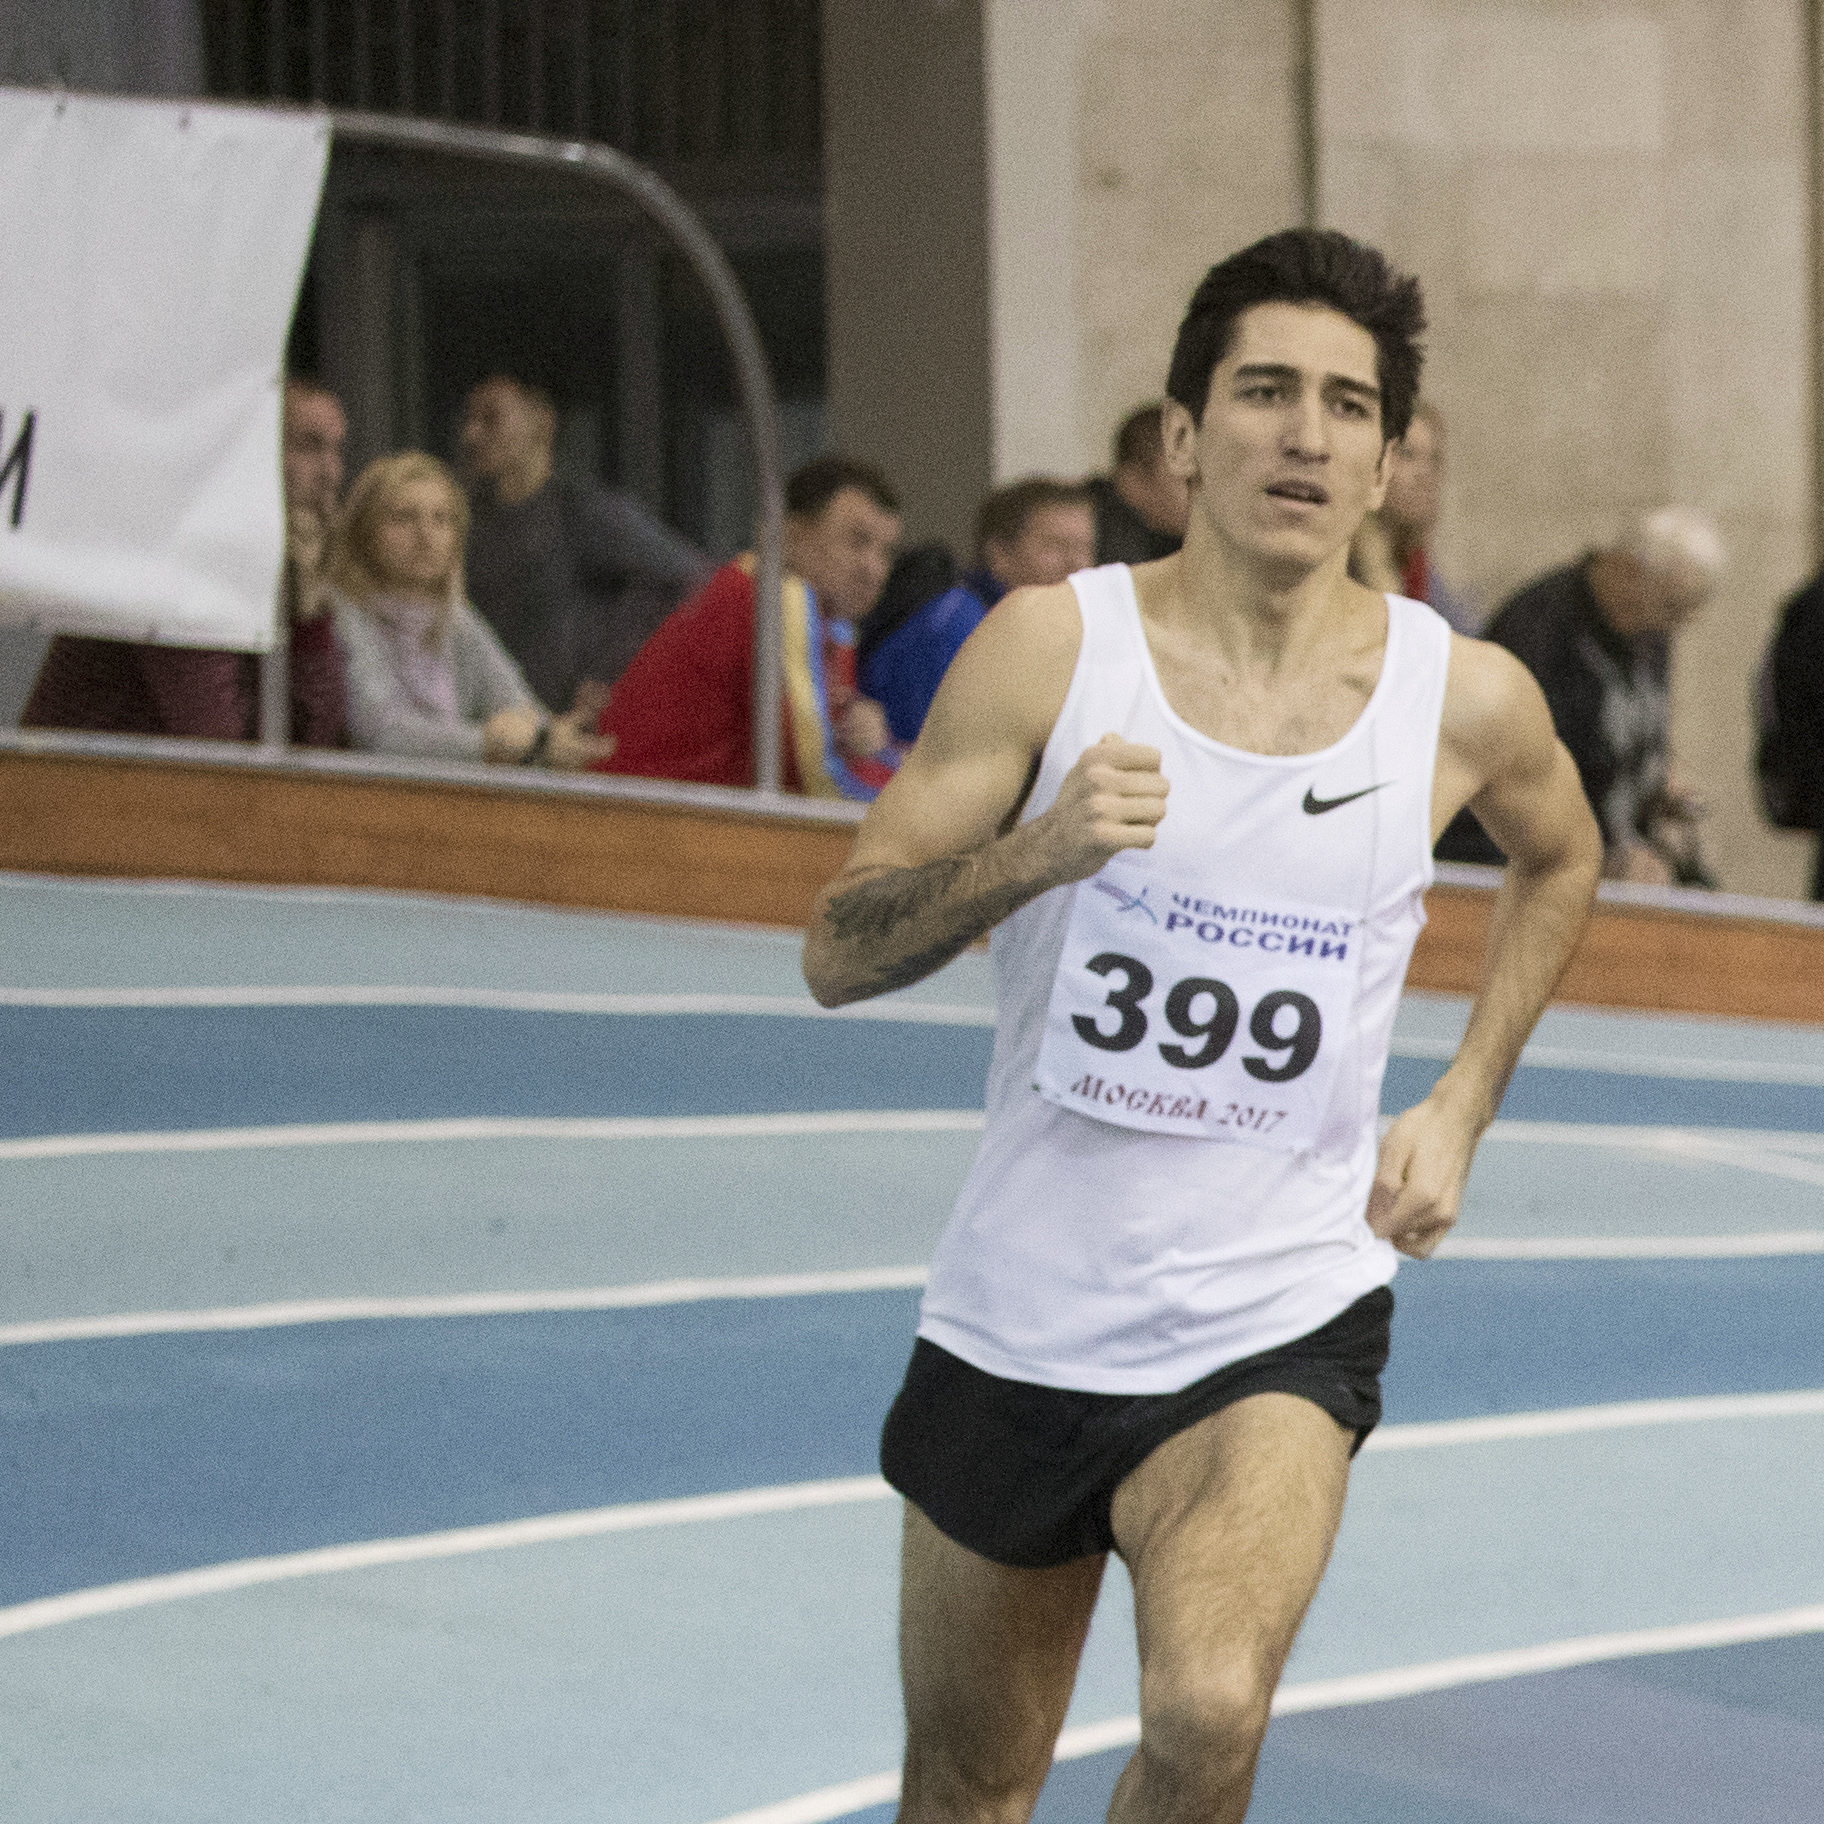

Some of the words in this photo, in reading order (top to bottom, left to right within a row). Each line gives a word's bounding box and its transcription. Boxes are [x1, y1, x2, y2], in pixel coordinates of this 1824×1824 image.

[1164, 911, 1349, 961] РОССИИ
[1172, 891, 1354, 936] ЧЕМПИОНАТ
[1071, 952, 1321, 1083] 399
[1071, 1073, 1208, 1120] МОСКВА
[1218, 1101, 1289, 1133] 2017
